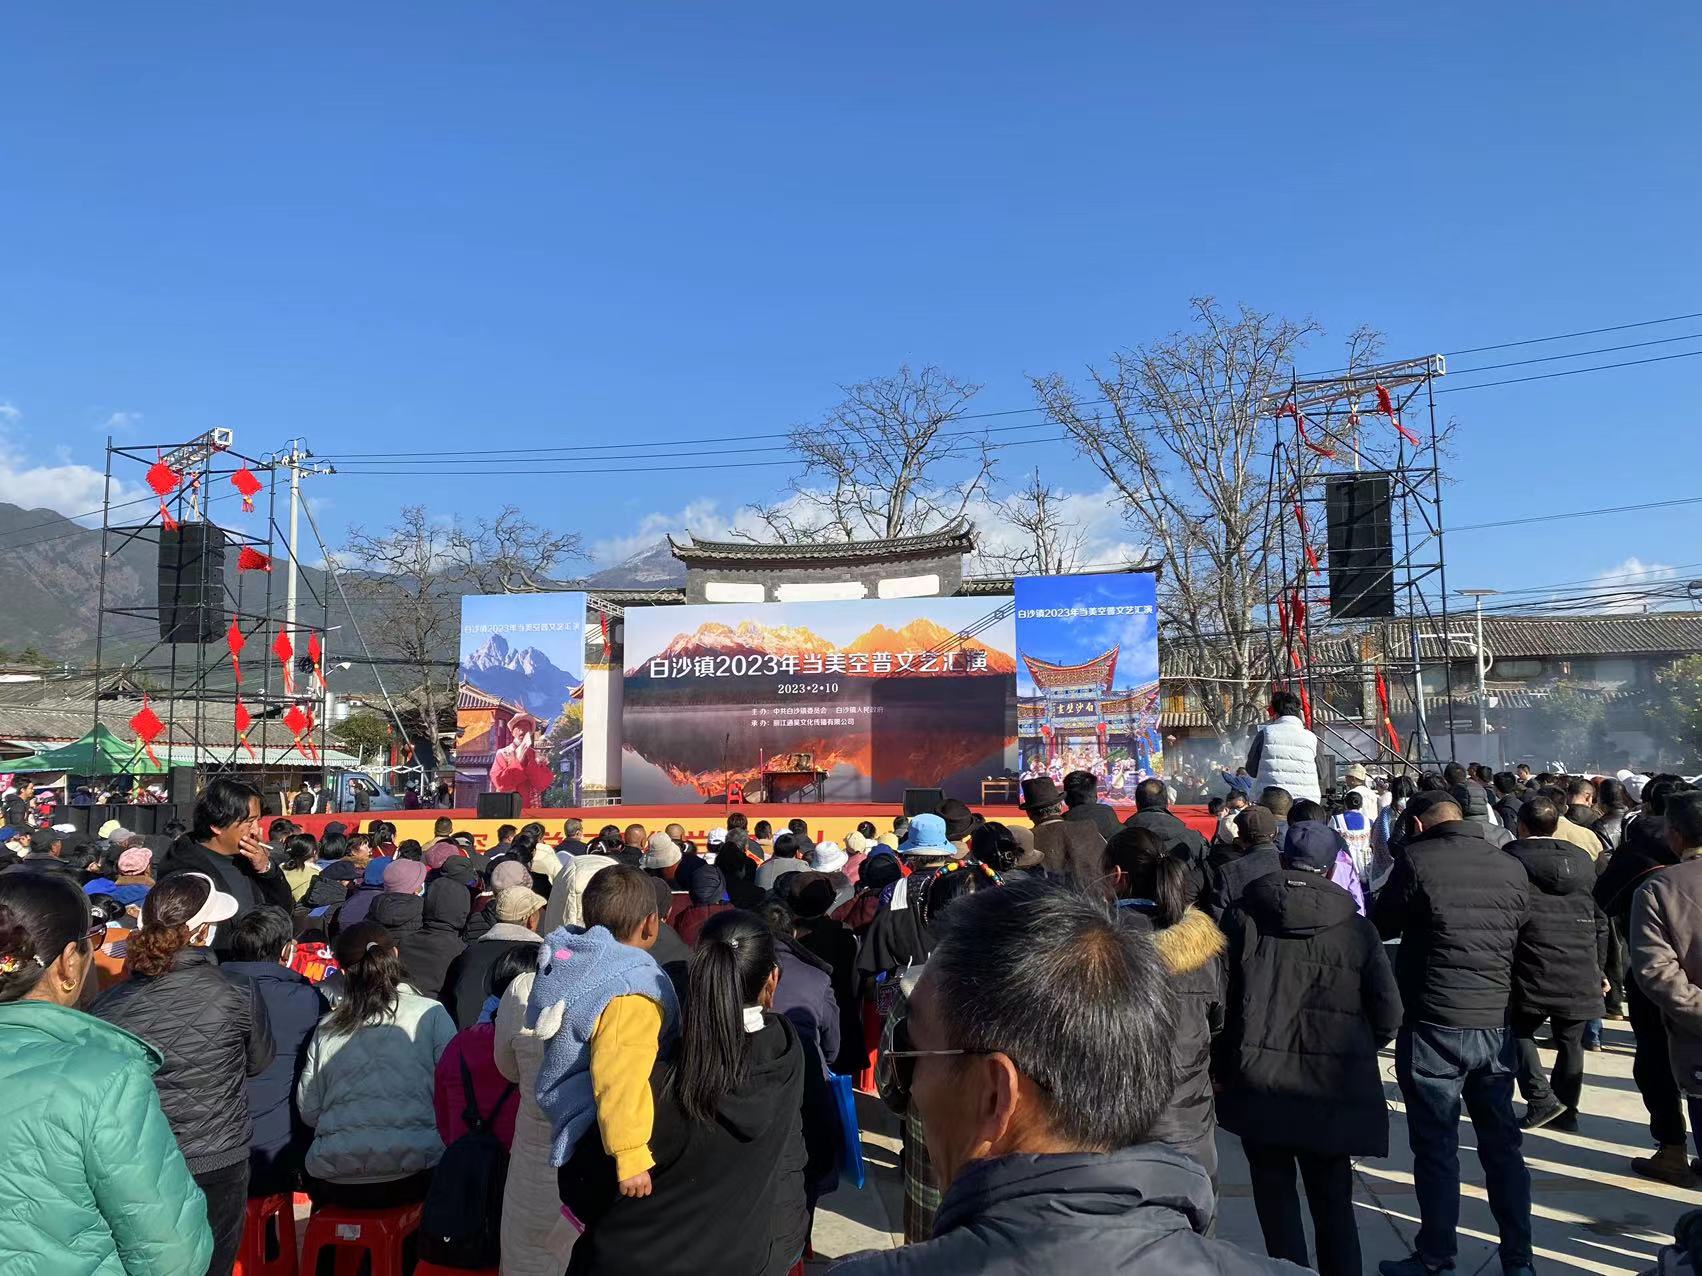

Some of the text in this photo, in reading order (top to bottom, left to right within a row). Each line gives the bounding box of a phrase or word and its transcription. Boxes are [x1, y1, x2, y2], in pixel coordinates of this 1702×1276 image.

[1018, 605, 1153, 619] 白沙镇2023年当美空普文艺汇演
[650, 651, 988, 679] 白沙镇2023年当美空普文艺汇演
